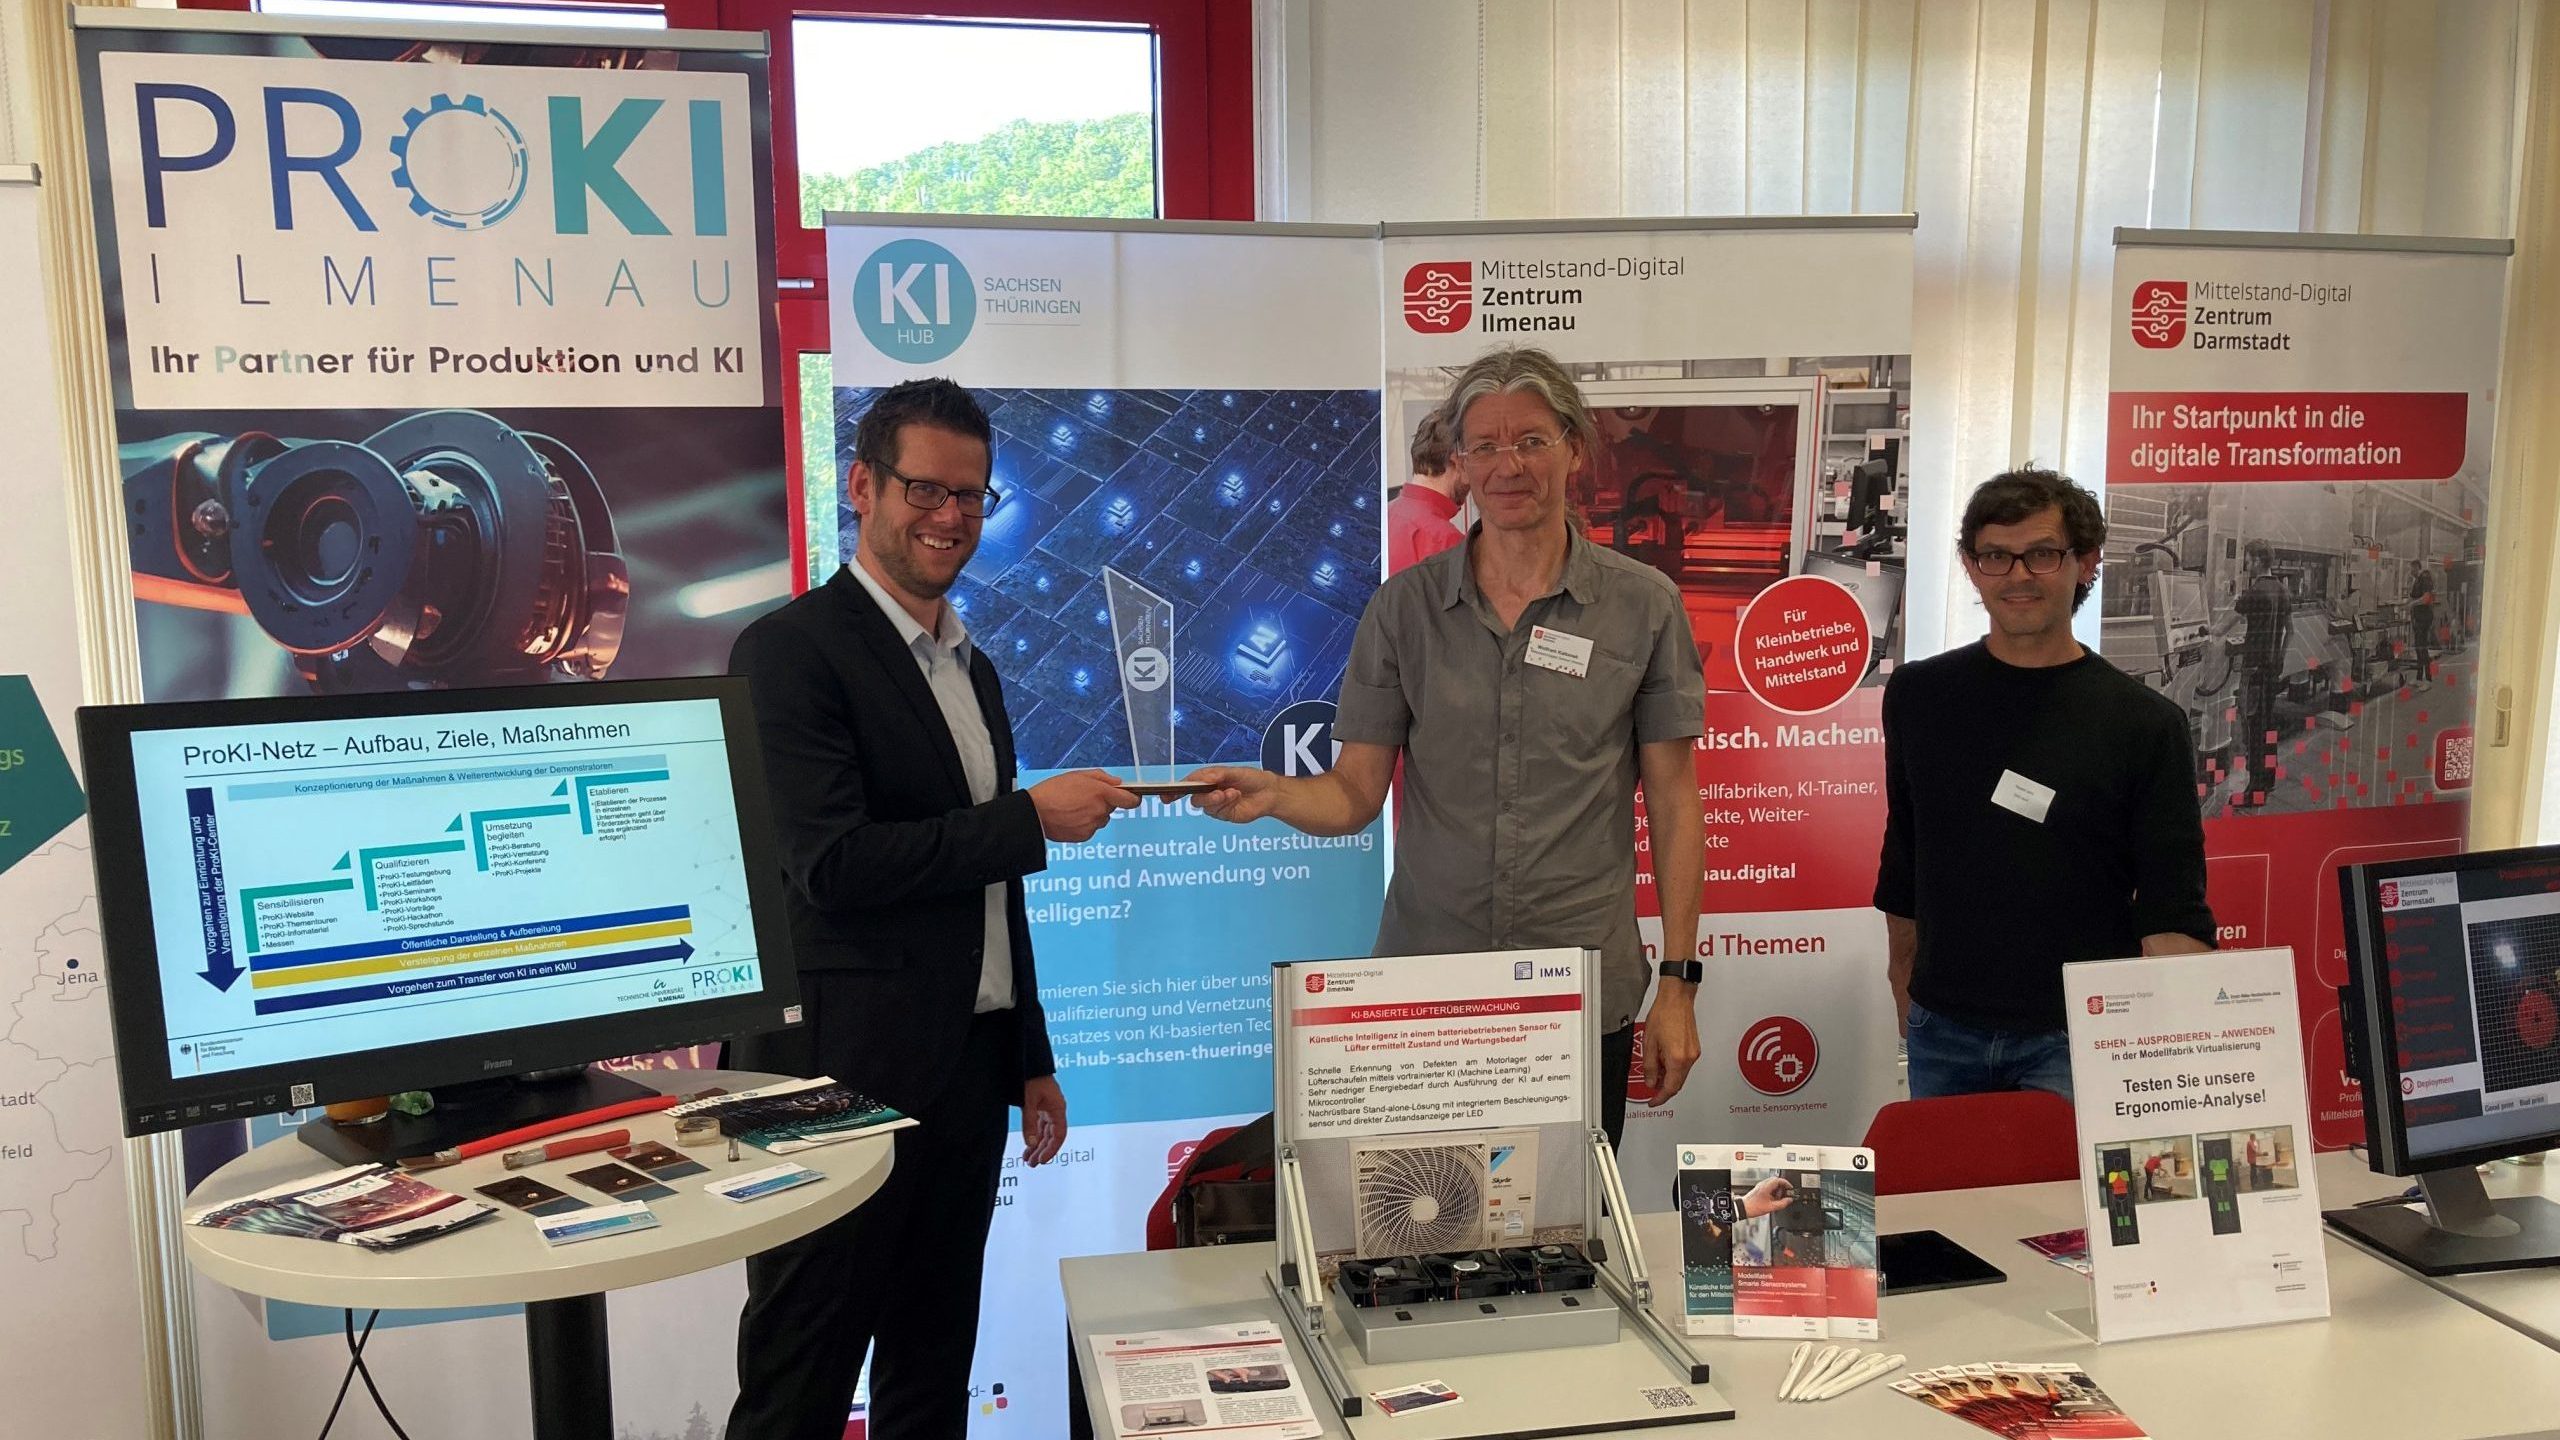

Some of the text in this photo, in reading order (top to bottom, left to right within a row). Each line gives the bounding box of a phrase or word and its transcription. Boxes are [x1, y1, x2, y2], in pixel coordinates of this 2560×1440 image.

[134, 81, 729, 237] PROKI
[1481, 256, 1685, 281] Mittelstand-Digital
[151, 252, 732, 308] ILMENAU
[983, 277, 1062, 293] SACHSEN
[878, 262, 951, 325] KI
[1481, 287, 1583, 306] Zentrum
[2194, 282, 2352, 306] Mittelstand-Digital
[983, 296, 1081, 314] THÜRINGEN
[2194, 306, 2272, 326] Zentrum
[1481, 313, 1576, 333] Ilmenau
[897, 329, 935, 345] HUB
[2193, 331, 2291, 351] Darmstadt
[151, 345, 745, 375] Ihr Partner für Produktion und KI
[2131, 403, 2366, 434] Ihr Startpunkt in die
[2130, 440, 2402, 473] digitale Transformation
[1783, 608, 1808, 625] Für
[1755, 621, 1857, 650] Kleinbetriebe,
[1754, 637, 1860, 671] Handwerk und
[1134, 656, 1156, 682] KI
[1764, 661, 1848, 689] Mittelstand
[183, 722, 631, 766] ProKI-Netz Aufbau, Ziele, Maßnahmen
[1775, 721, 1886, 748] Machen.
[294, 762, 614, 794] Konzeptionierung der Maßnahmen & Weiterentwicklung der Demonstratoren
[589, 787, 629, 797] Etablieren
[1699, 781, 1878, 800] ellfabriken, KI-Trainer,
[191, 816, 202, 834] und
[1748, 806, 1811, 823] Weiter-
[485, 821, 533, 832] Umsetzung
[486, 831, 525, 842] begleiten
[1047, 835, 1217, 862] nbieterneutrale
[375, 858, 430, 870] Qualifizieren
[213, 876, 224, 893] der
[1088, 864, 1310, 889] und Anwendung von
[201, 890, 212, 906] zur
[257, 897, 324, 910] Sensibilisieren
[1026, 899, 1132, 926] telligenz?
[203, 907, 217, 956] Vorgehen
[401, 924, 562, 950] Öffentliche Darstellung & Aufbereitung
[1719, 934, 1826, 956] Themen
[57, 971, 99, 985] Jena
[387, 961, 577, 995] Vorgehen zum Transfer von KI in ein KMU
[1539, 966, 1572, 978] IMMS
[1038, 984, 1098, 1001] mieren
[1102, 980, 1126, 997] Sie
[1131, 979, 1162, 995] sich
[1166, 977, 1196, 992] hier
[1201, 974, 1236, 991] über
[1047, 1004, 1147, 1024] ualifizierung
[1151, 1000, 1183, 1016] und
[1350, 1002, 1521, 1020] KI-BASIERTE LÜFTERÜBERWACHUNG
[1115, 1027, 1145, 1042] von
[1149, 1021, 1243, 1040] KI-basierten
[1246, 1019, 1273, 1032] Tec
[1309, 1022, 1562, 1044] Künstliche Intelligenz in einem batteriebetriebenen Sensor für
[2094, 1026, 2276, 1050] SEHEN AUSPROBIEREN ANWENDEN
[1344, 1034, 1527, 1052] Lüfter ermittelt Zustand und Wartungsbedarf
[2111, 1040, 2261, 1062] in der Modellfabrik Virtualisierung
[1054, 1041, 1273, 1070] ki-hub-sachsen-thueringe
[1307, 1066, 1341, 1075] Schnelle
[1349, 1064, 1392, 1073] Erkennung
[1422, 1060, 1457, 1068] Defekten
[1486, 1056, 1527, 1065] Motorlager
[1446, 1069, 1456, 1077] KI
[2122, 1070, 2256, 1094] Testen Sie unsere
[1308, 1088, 1327, 1096] Sehr
[1427, 1080, 1450, 1089] durch
[1530, 1074, 1544, 1082] auf
[1547, 1073, 1571, 1081] einem
[1466, 1109, 1484, 1117] LED
[1626, 1109, 1674, 1119] ualisierung
[1729, 1101, 1828, 1114] Smarte Sensorsysteme
[2114, 1088, 2267, 1118] Ergonomie-Analyse!
[2320, 1109, 2365, 1122] Mittelstan
[1854, 1156, 1866, 1167] KI
